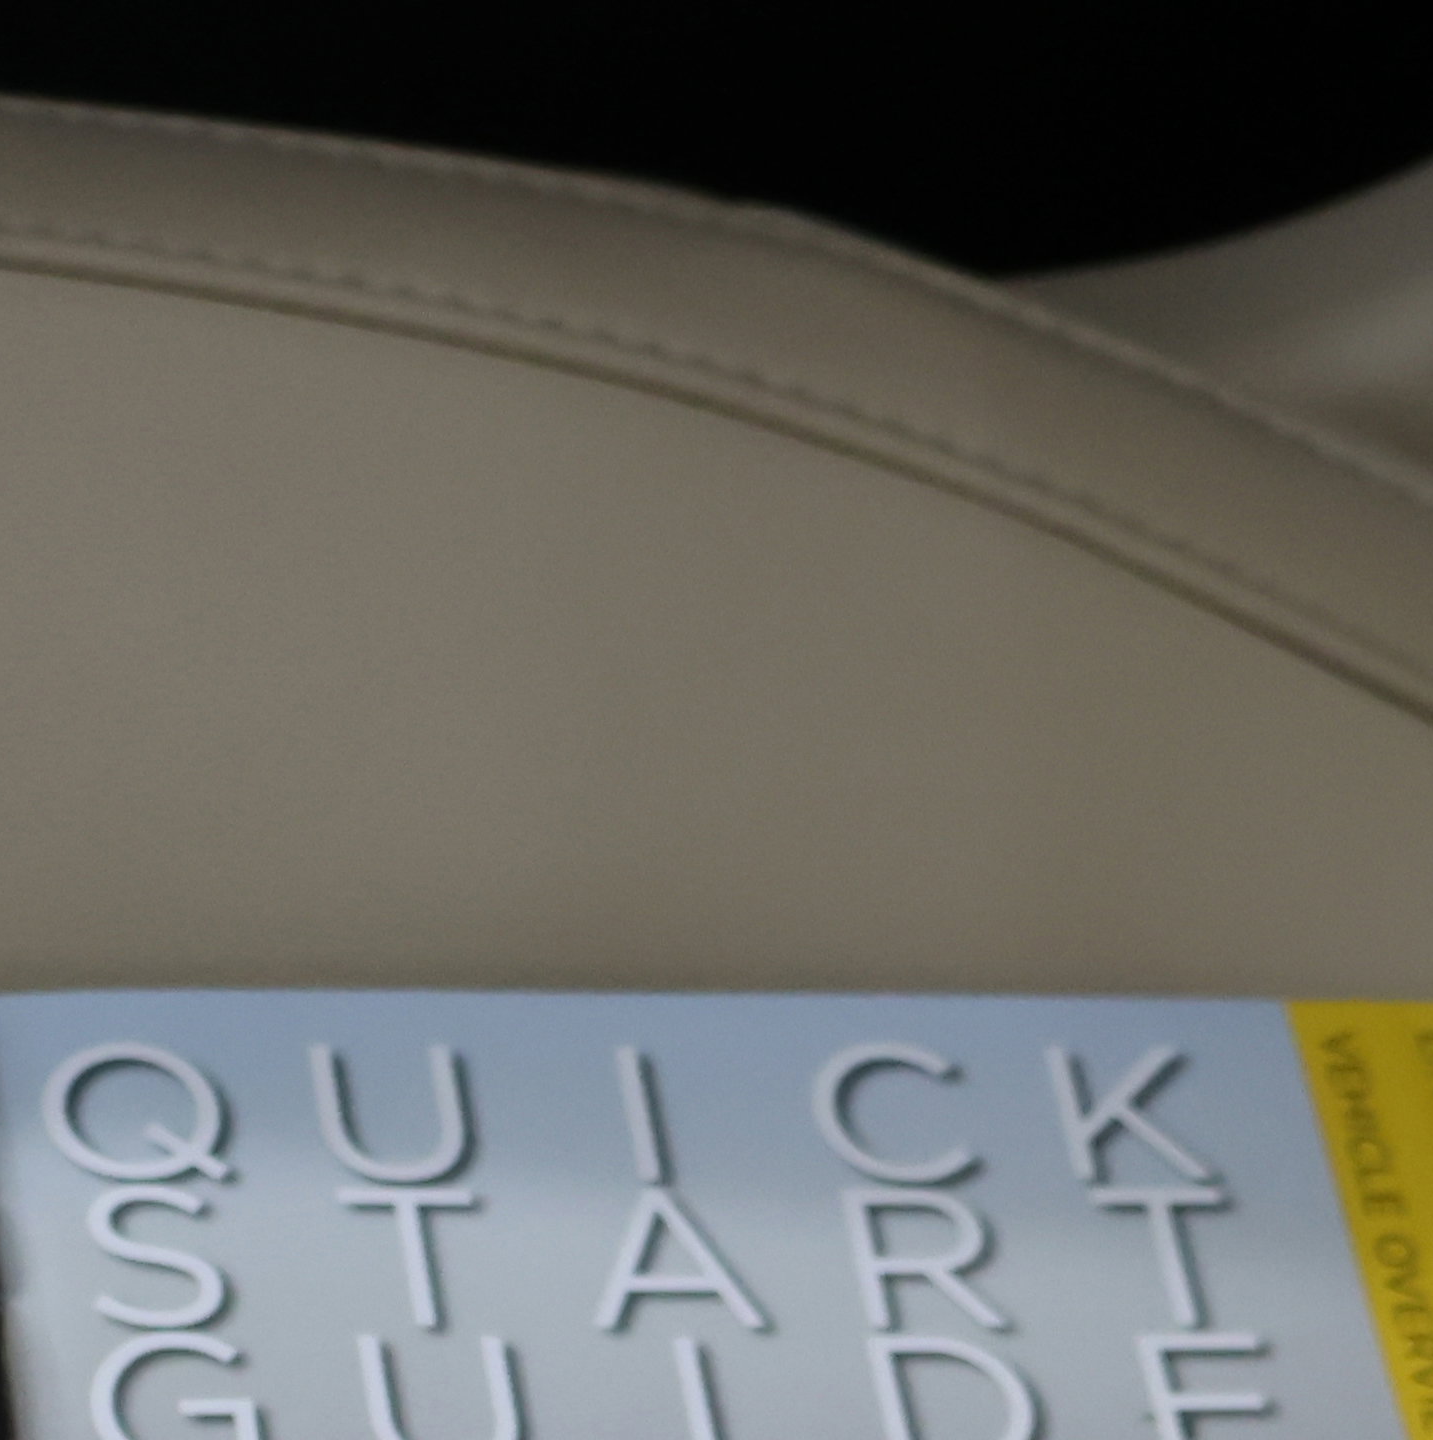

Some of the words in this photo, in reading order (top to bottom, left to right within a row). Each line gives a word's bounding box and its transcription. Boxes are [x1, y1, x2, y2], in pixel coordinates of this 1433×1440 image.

[41, 1041, 1221, 1184] QUICK
[1320, 1031, 1406, 1215] VEHICLE
[87, 1184, 1230, 1334] START
